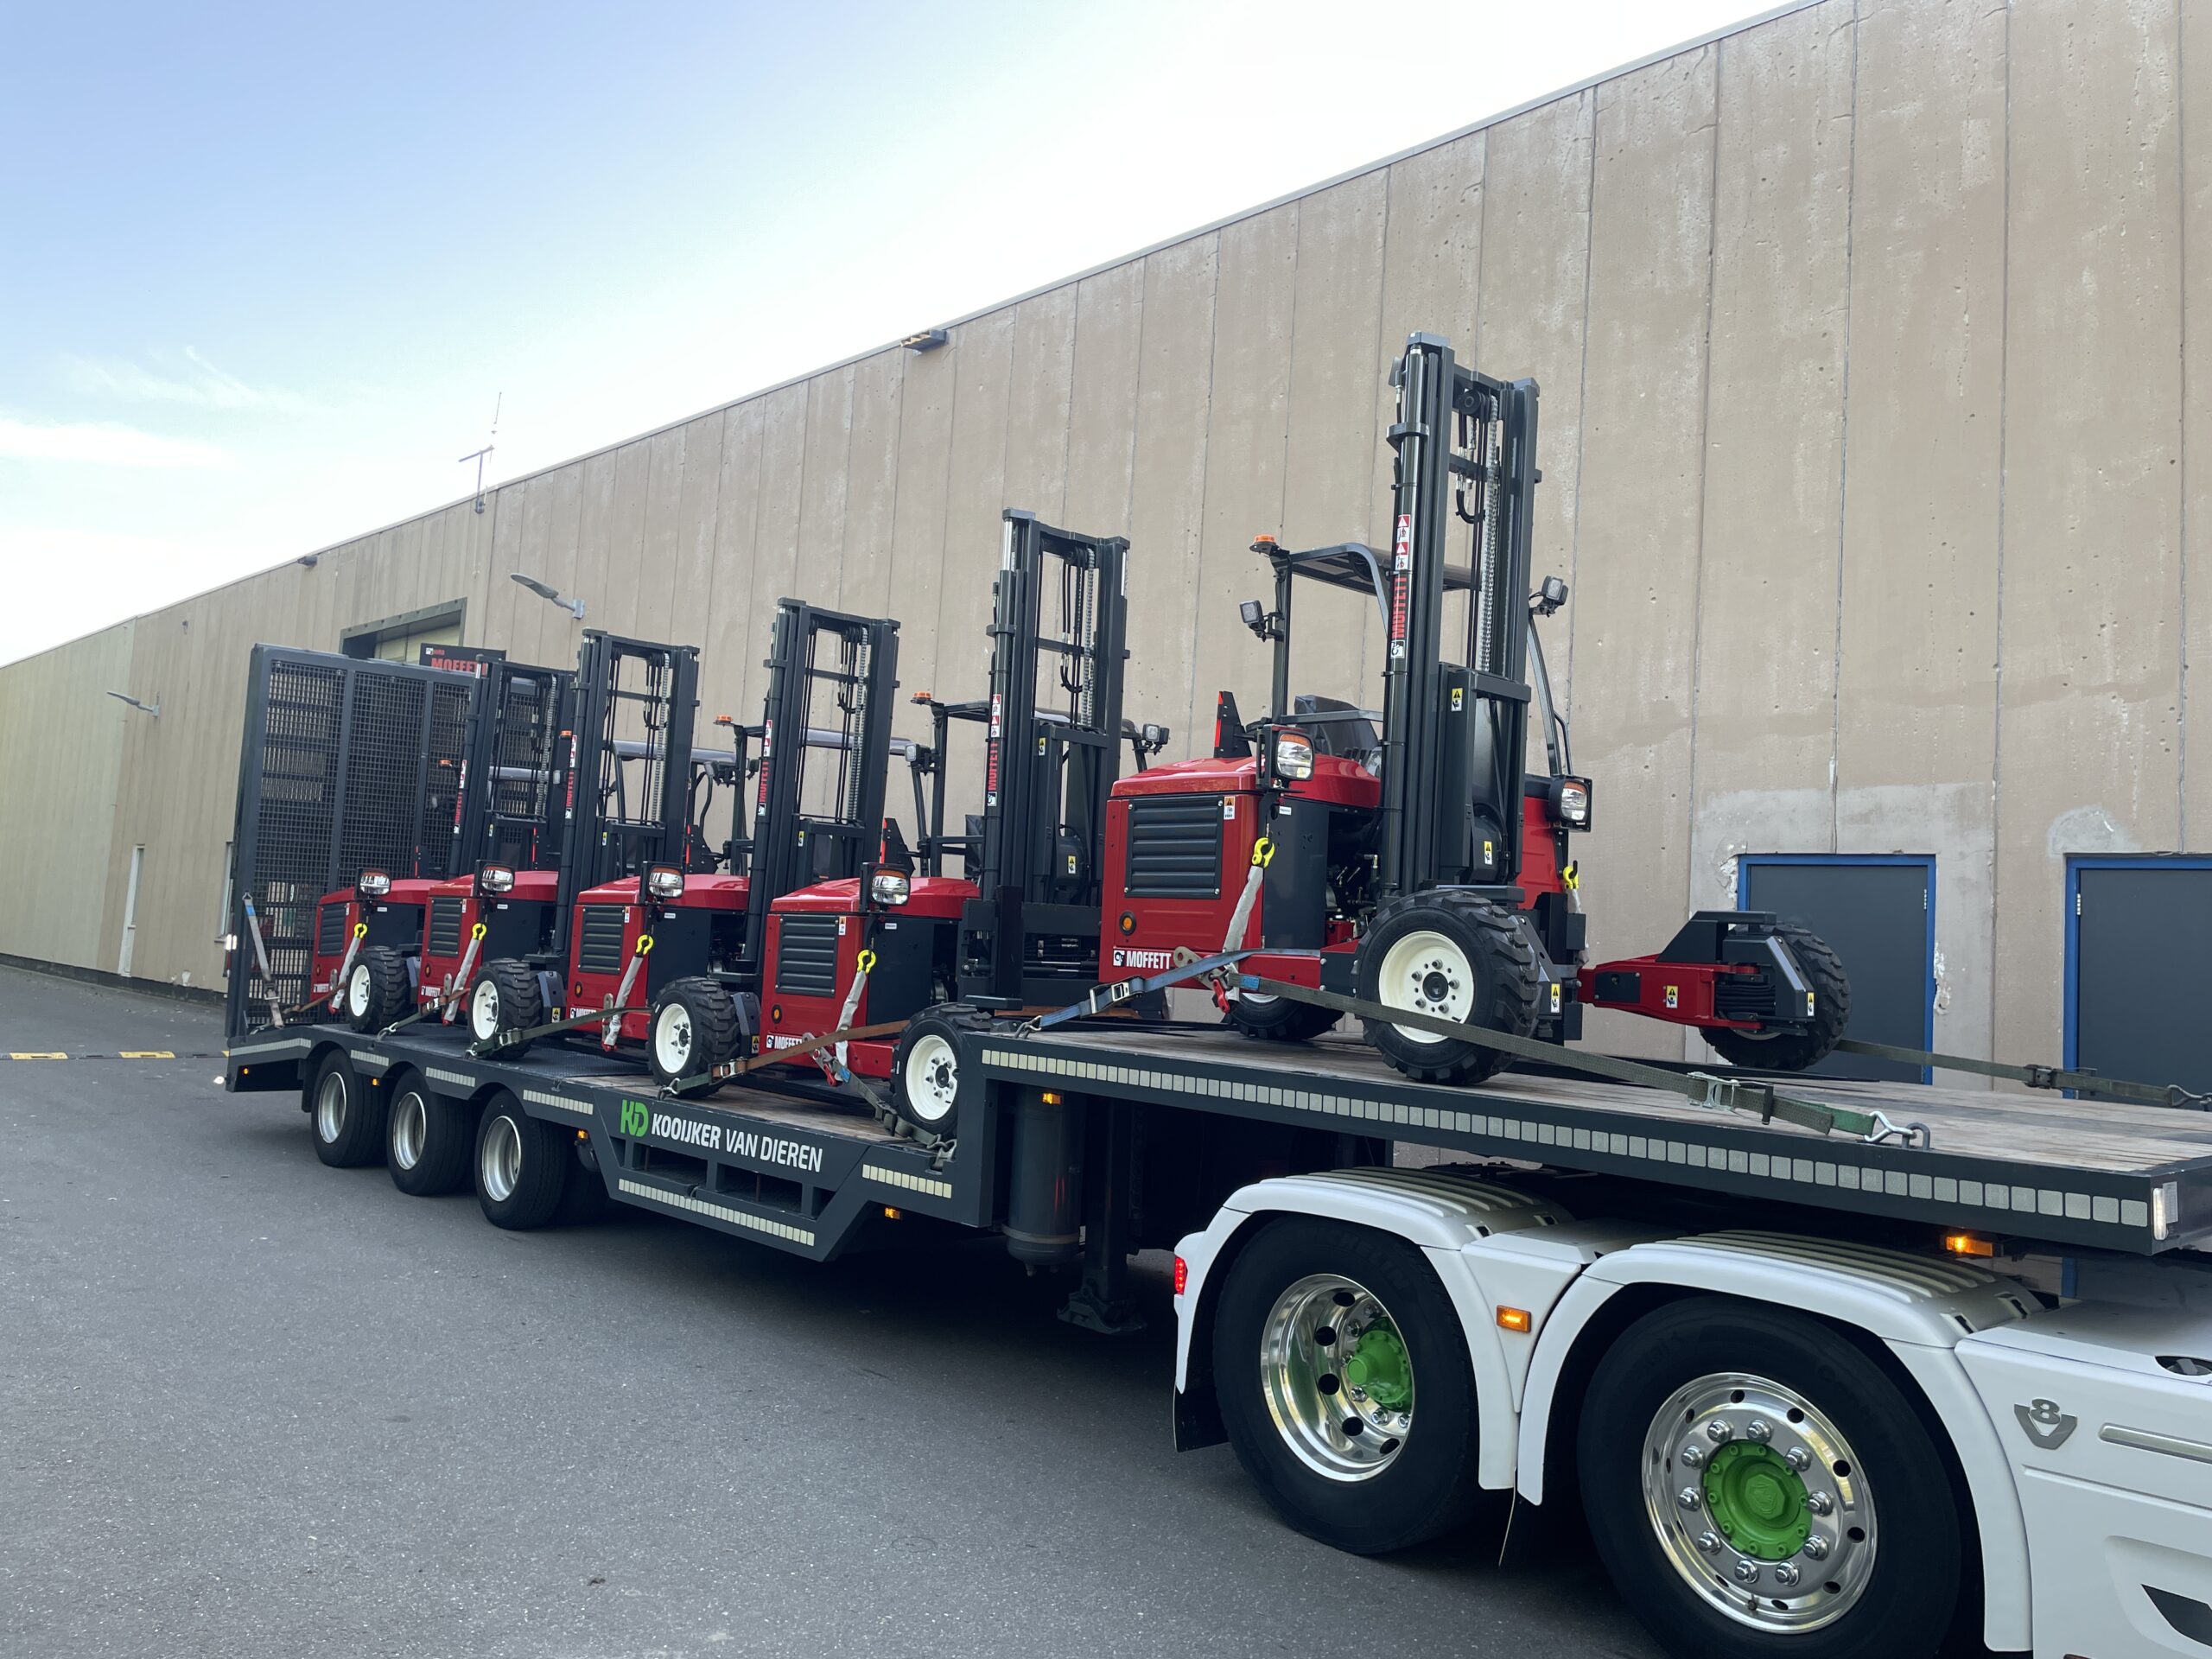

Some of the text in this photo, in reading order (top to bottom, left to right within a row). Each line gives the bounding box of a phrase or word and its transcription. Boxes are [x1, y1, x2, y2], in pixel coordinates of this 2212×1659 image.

[1126, 950, 1172, 969] MOFFETT
[652, 1113, 721, 1150] KOOIJKER
[726, 1128, 759, 1158] VAN
[760, 1136, 823, 1173] DIEREN
